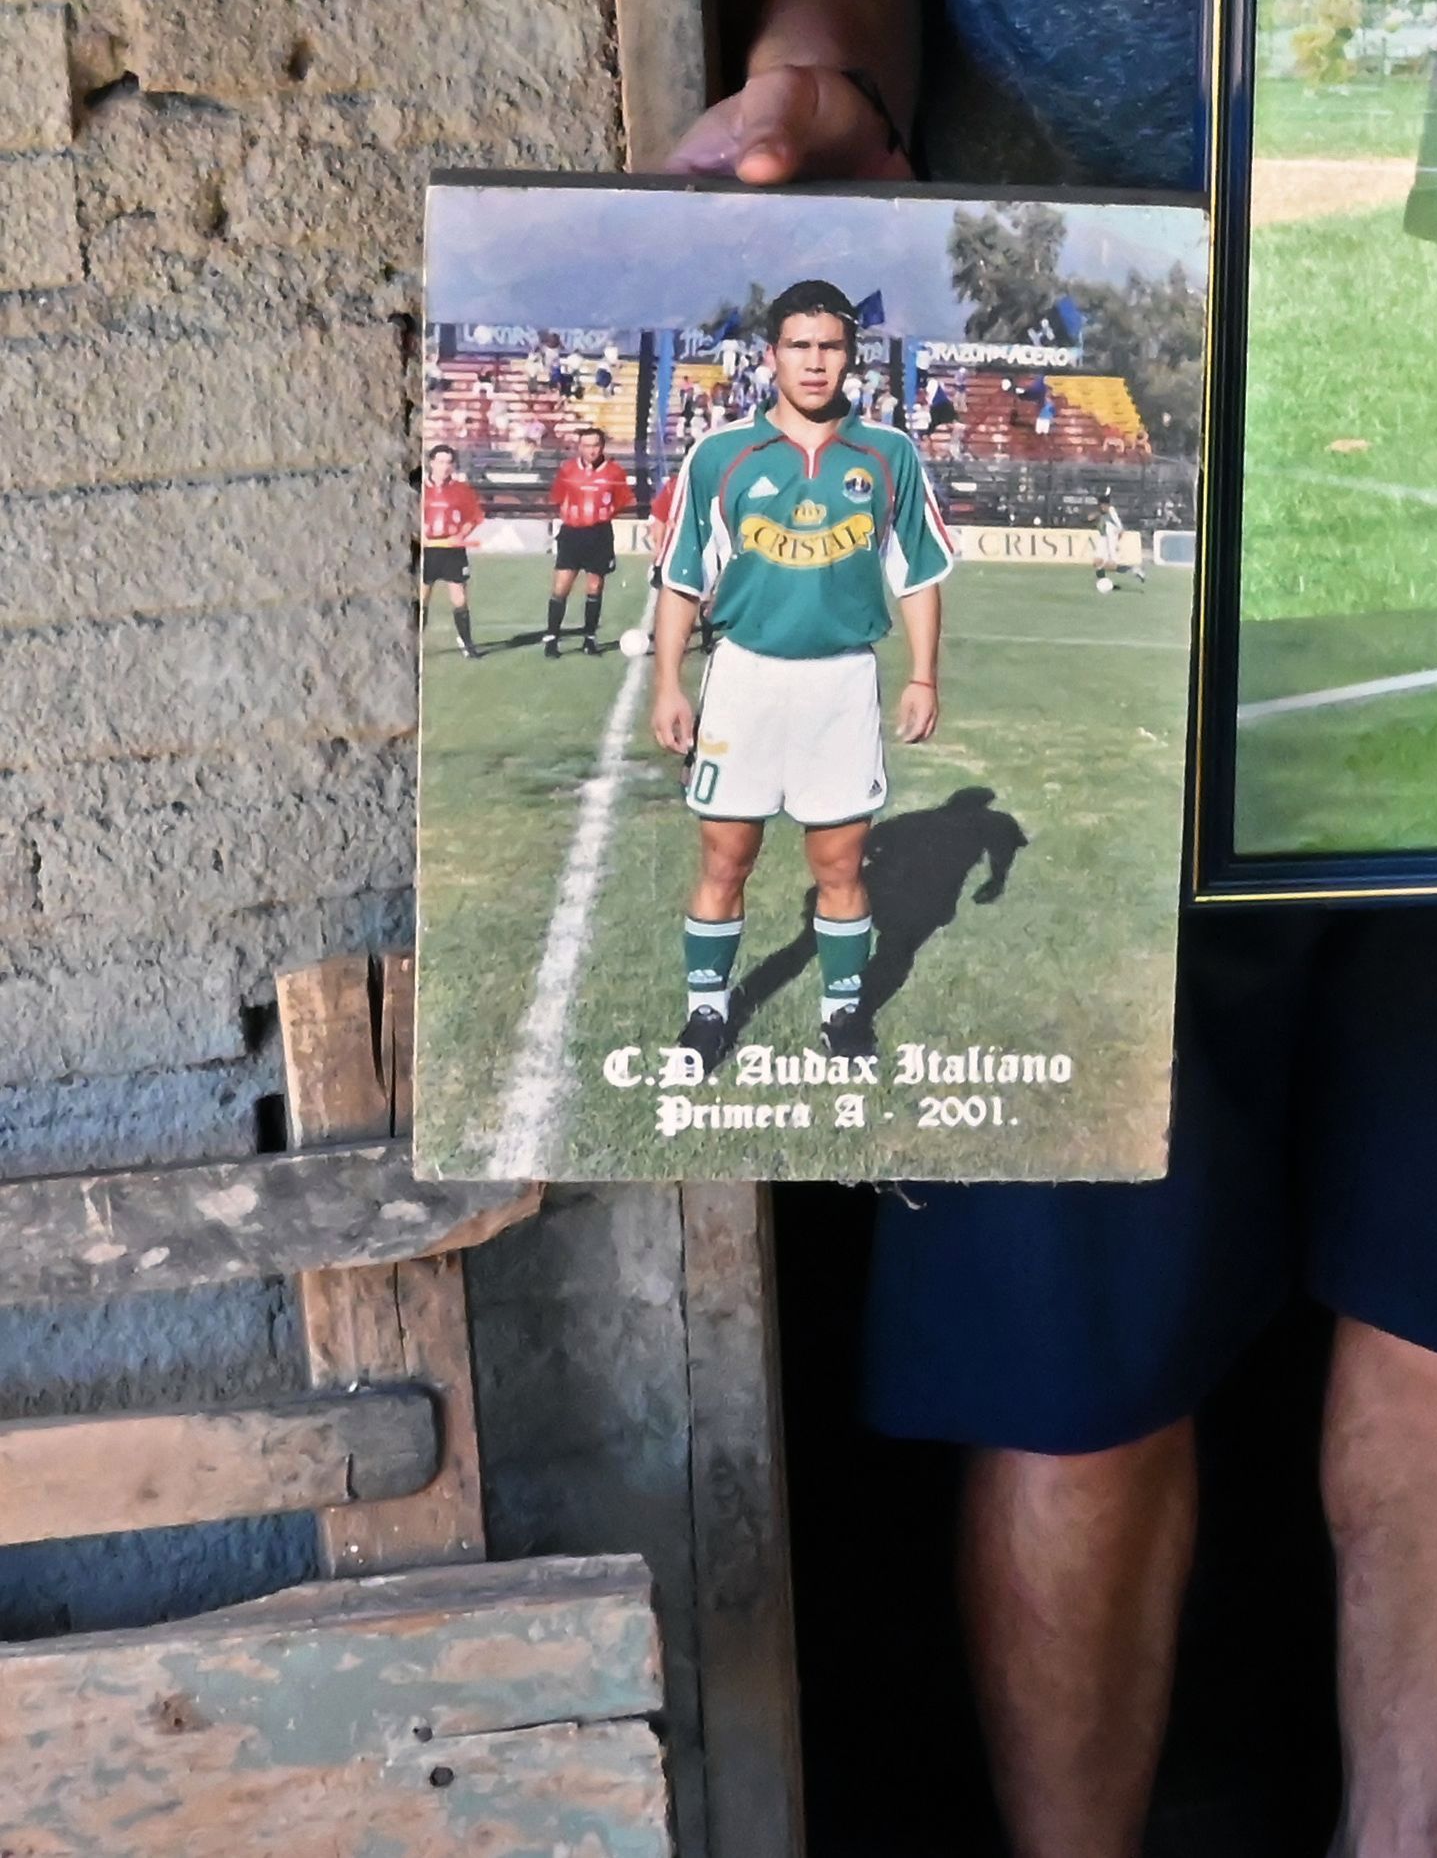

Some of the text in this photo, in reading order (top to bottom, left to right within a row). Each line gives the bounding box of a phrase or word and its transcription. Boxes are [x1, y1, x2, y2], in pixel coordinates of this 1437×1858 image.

[753, 525, 857, 559] CRISTAL
[977, 531, 1099, 558] CRISTA
[603, 1043, 1073, 1089] C.D. Audax Italiano
[655, 1094, 812, 1137] Primera
[833, 1093, 866, 1128] A
[917, 1095, 1019, 1128] 2001.
